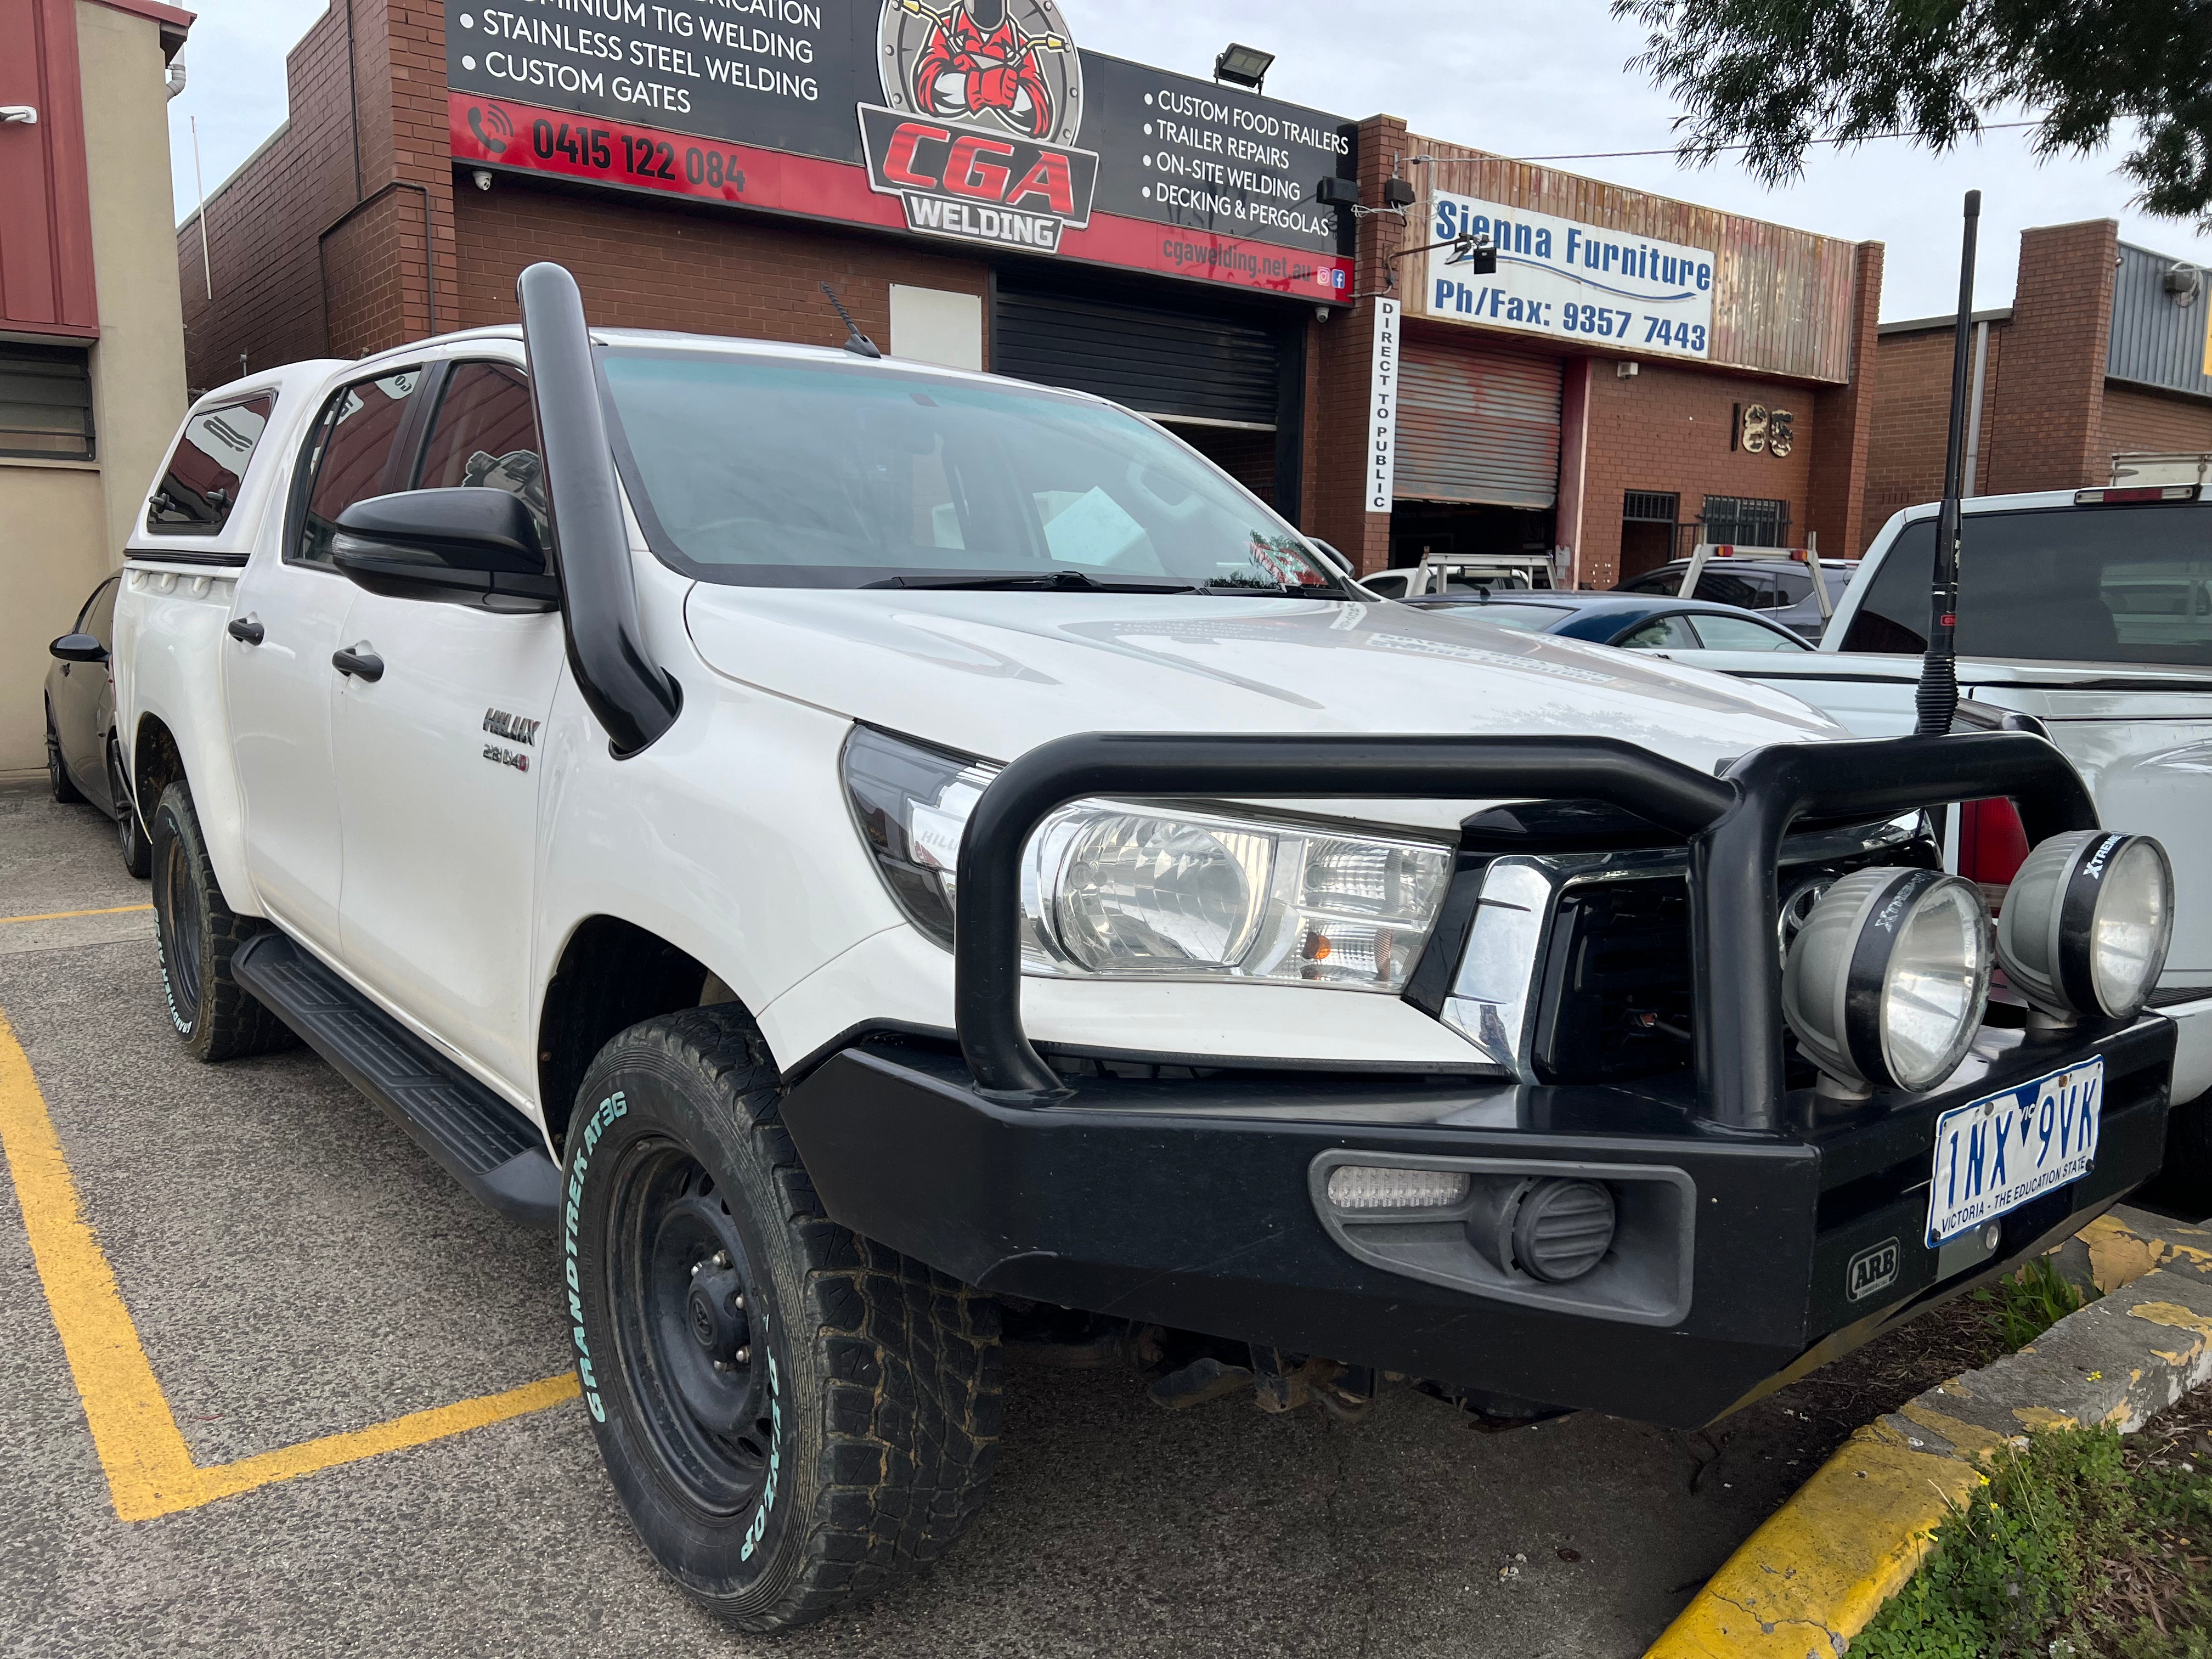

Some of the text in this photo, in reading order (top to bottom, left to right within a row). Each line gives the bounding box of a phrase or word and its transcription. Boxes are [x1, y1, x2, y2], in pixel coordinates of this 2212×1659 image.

[483, 9, 819, 101] STAINLESS STEEL WELDING
[652, 5, 694, 37] TIG
[699, 16, 813, 64] WELDING
[486, 51, 691, 113] CUSTOM GATES
[1156, 119, 1289, 170] TRAILER REPAIRS
[1158, 90, 1349, 155] CUSTOM FOOD TRAILERS
[533, 119, 746, 192] 0415 122 084
[883, 122, 1075, 215] CGA
[1156, 151, 1301, 201] ON-SITE WELDING
[910, 196, 1056, 247] WELDING
[1156, 182, 1329, 237] DECKING & PERGOLAS
[1163, 239, 1311, 282] cgawelding.net.au
[1436, 200, 1711, 291] Sienna Furniture
[1435, 279, 1706, 352] Ph/Fax: 9357 7443
[1374, 302, 1393, 507] DIRECT TO PUBLIC
[483, 707, 541, 747] HILUX
[921, 831, 960, 851] HILU
[2083, 834, 2123, 880] XTREME
[584, 1091, 628, 1156] AT3G
[1949, 1078, 2097, 1209] 1NX 9VK
[2020, 1103, 2036, 1122] VIC
[1942, 1201, 1984, 1233] VICTORIA
[1994, 1188, 2011, 1209] THE
[2014, 1167, 2062, 1200] EDUCATION
[2062, 1156, 2086, 1177] STATE
[565, 1147, 606, 1423] GRANDTREK
[1854, 1249, 1894, 1290] ARB
[741, 1345, 781, 1562] DUNLOP
